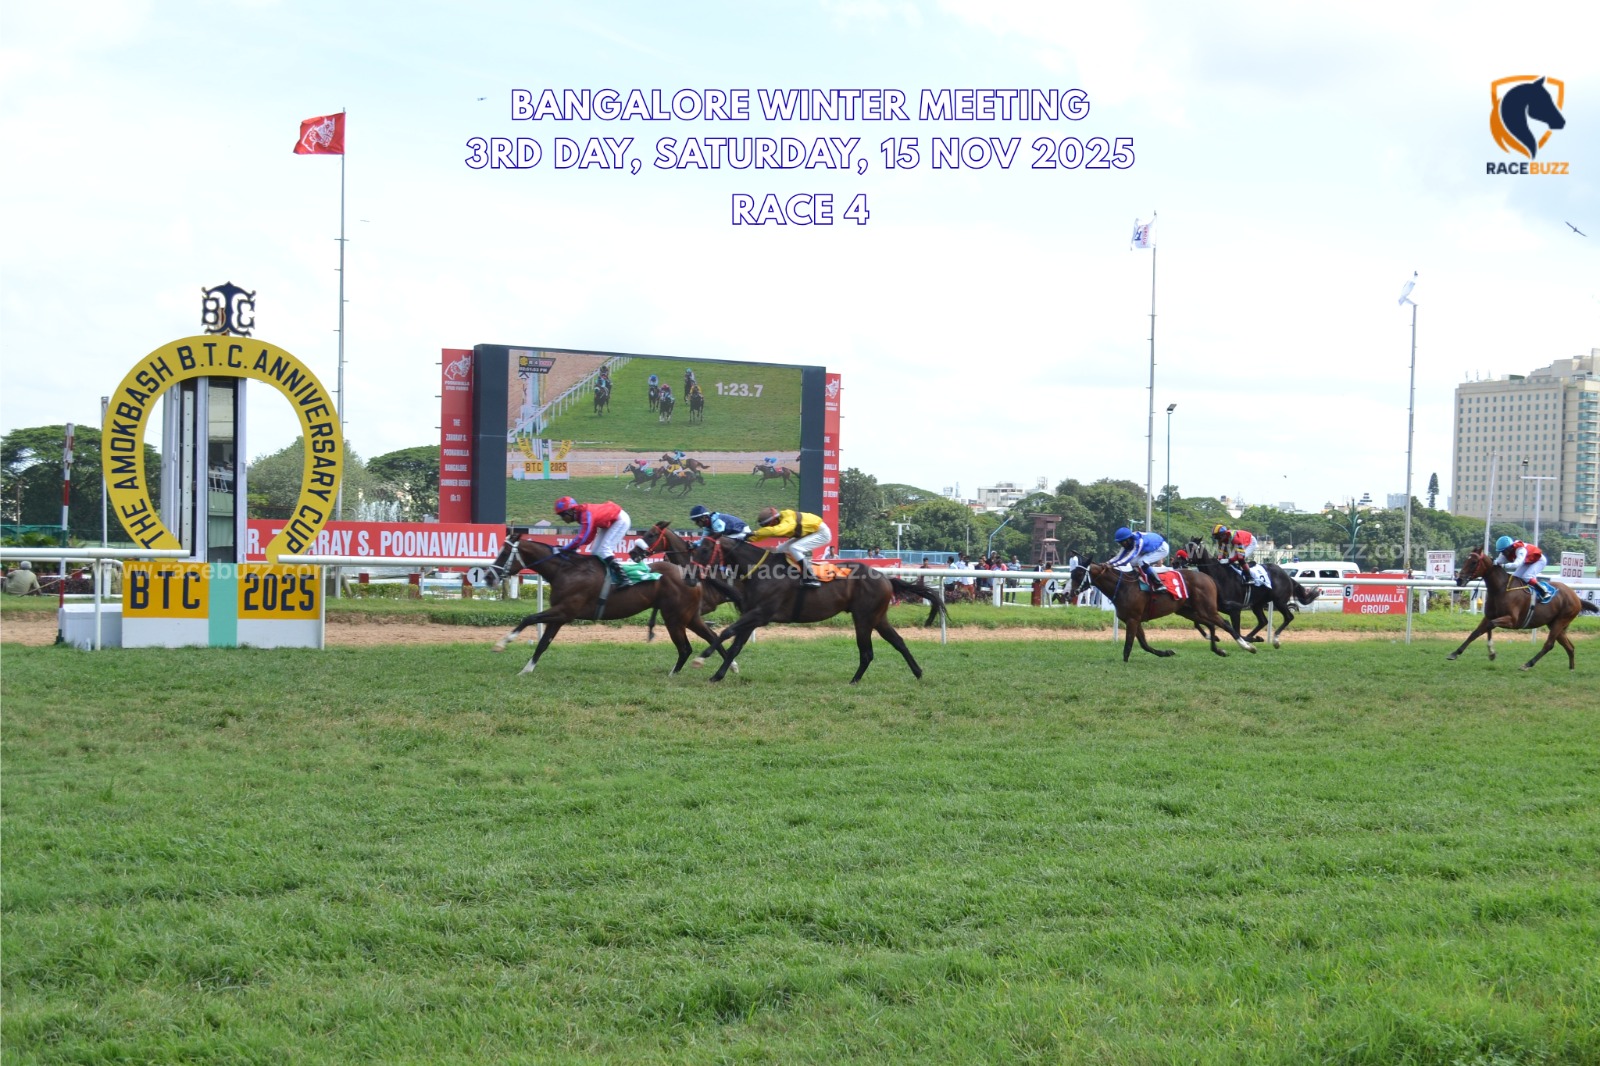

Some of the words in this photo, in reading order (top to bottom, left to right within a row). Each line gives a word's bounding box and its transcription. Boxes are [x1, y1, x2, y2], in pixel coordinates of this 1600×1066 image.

[177, 342, 249, 371] B.T.C.
[715, 382, 764, 398] 1:23.7
[110, 356, 174, 490] AMOKBASH
[253, 349, 336, 503] ANNIVERSARY
[525, 462, 542, 472] BTC
[550, 462, 567, 472] 2025
[121, 498, 164, 550] THE
[286, 505, 323, 554] CUP
[357, 531, 375, 556] S.
[380, 531, 498, 558] POONAWALLA
[1562, 557, 1584, 567] GOING
[472, 569, 479, 582] 1
[1562, 568, 1582, 578] GOOD
[130, 570, 200, 610] BTC
[244, 572, 315, 611] 2025
[1048, 581, 1056, 593] 4
[1344, 586, 1352, 597] 6
[1360, 605, 1390, 614] GROUP
